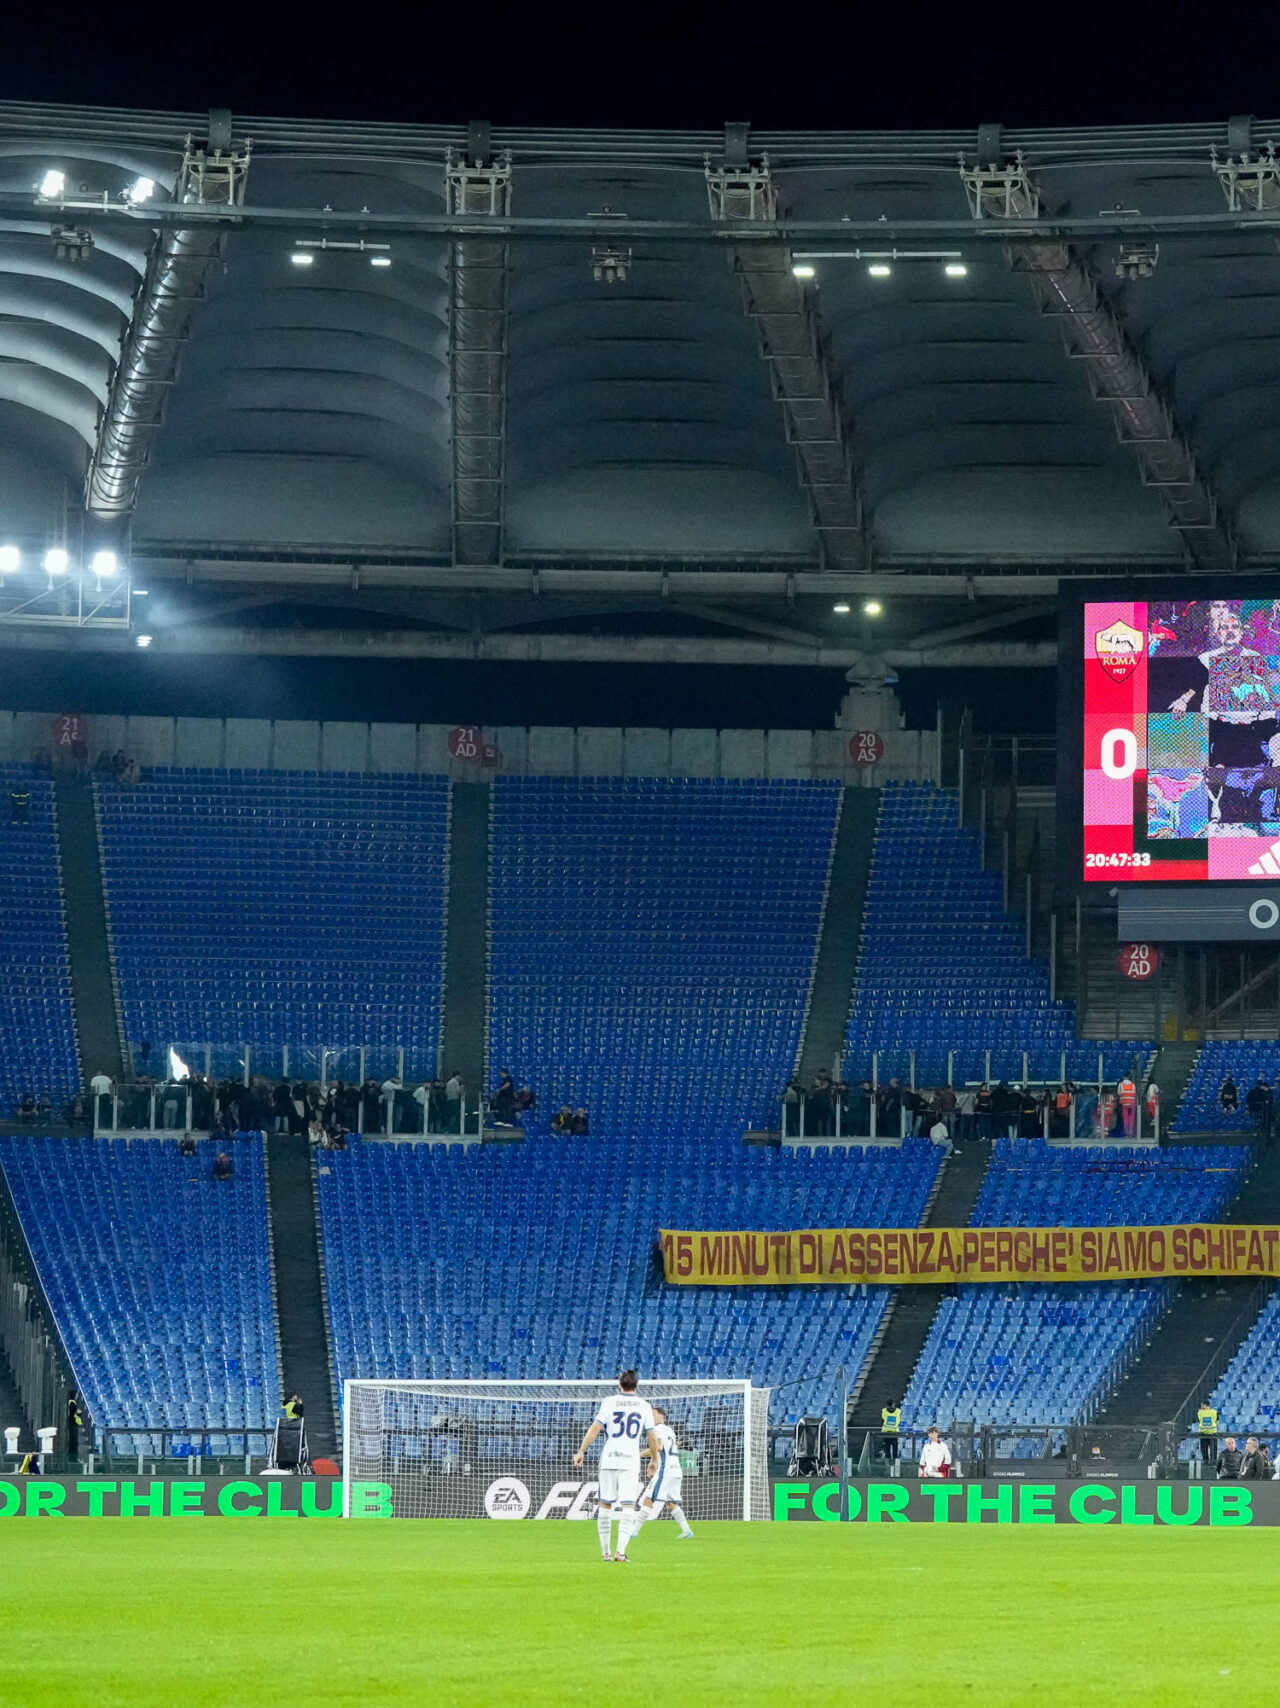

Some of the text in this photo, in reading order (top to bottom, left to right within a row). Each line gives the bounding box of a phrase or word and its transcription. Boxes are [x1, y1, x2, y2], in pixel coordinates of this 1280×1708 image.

[1103, 656, 1136, 666] ROMA
[62, 716, 78, 731] 21
[457, 728, 473, 743] 21
[858, 733, 876, 748] 20
[455, 743, 477, 757] AD
[857, 748, 877, 762] AS
[1101, 728, 1137, 780] 0
[1130, 944, 1149, 959] 20
[1127, 960, 1151, 976] AD
[663, 1234, 693, 1276] 15
[700, 1234, 792, 1276] MINUTI
[799, 1234, 824, 1275] DI
[1081, 1230, 1166, 1273] SIAMO
[611, 1411, 642, 1439] 36
[77, 1480, 205, 1518] THE
[217, 1480, 394, 1519] CLUB
[493, 1487, 523, 1503] EA
[491, 1503, 524, 1512] SPORTS
[774, 1482, 1254, 1527] FOR THE CLUB
